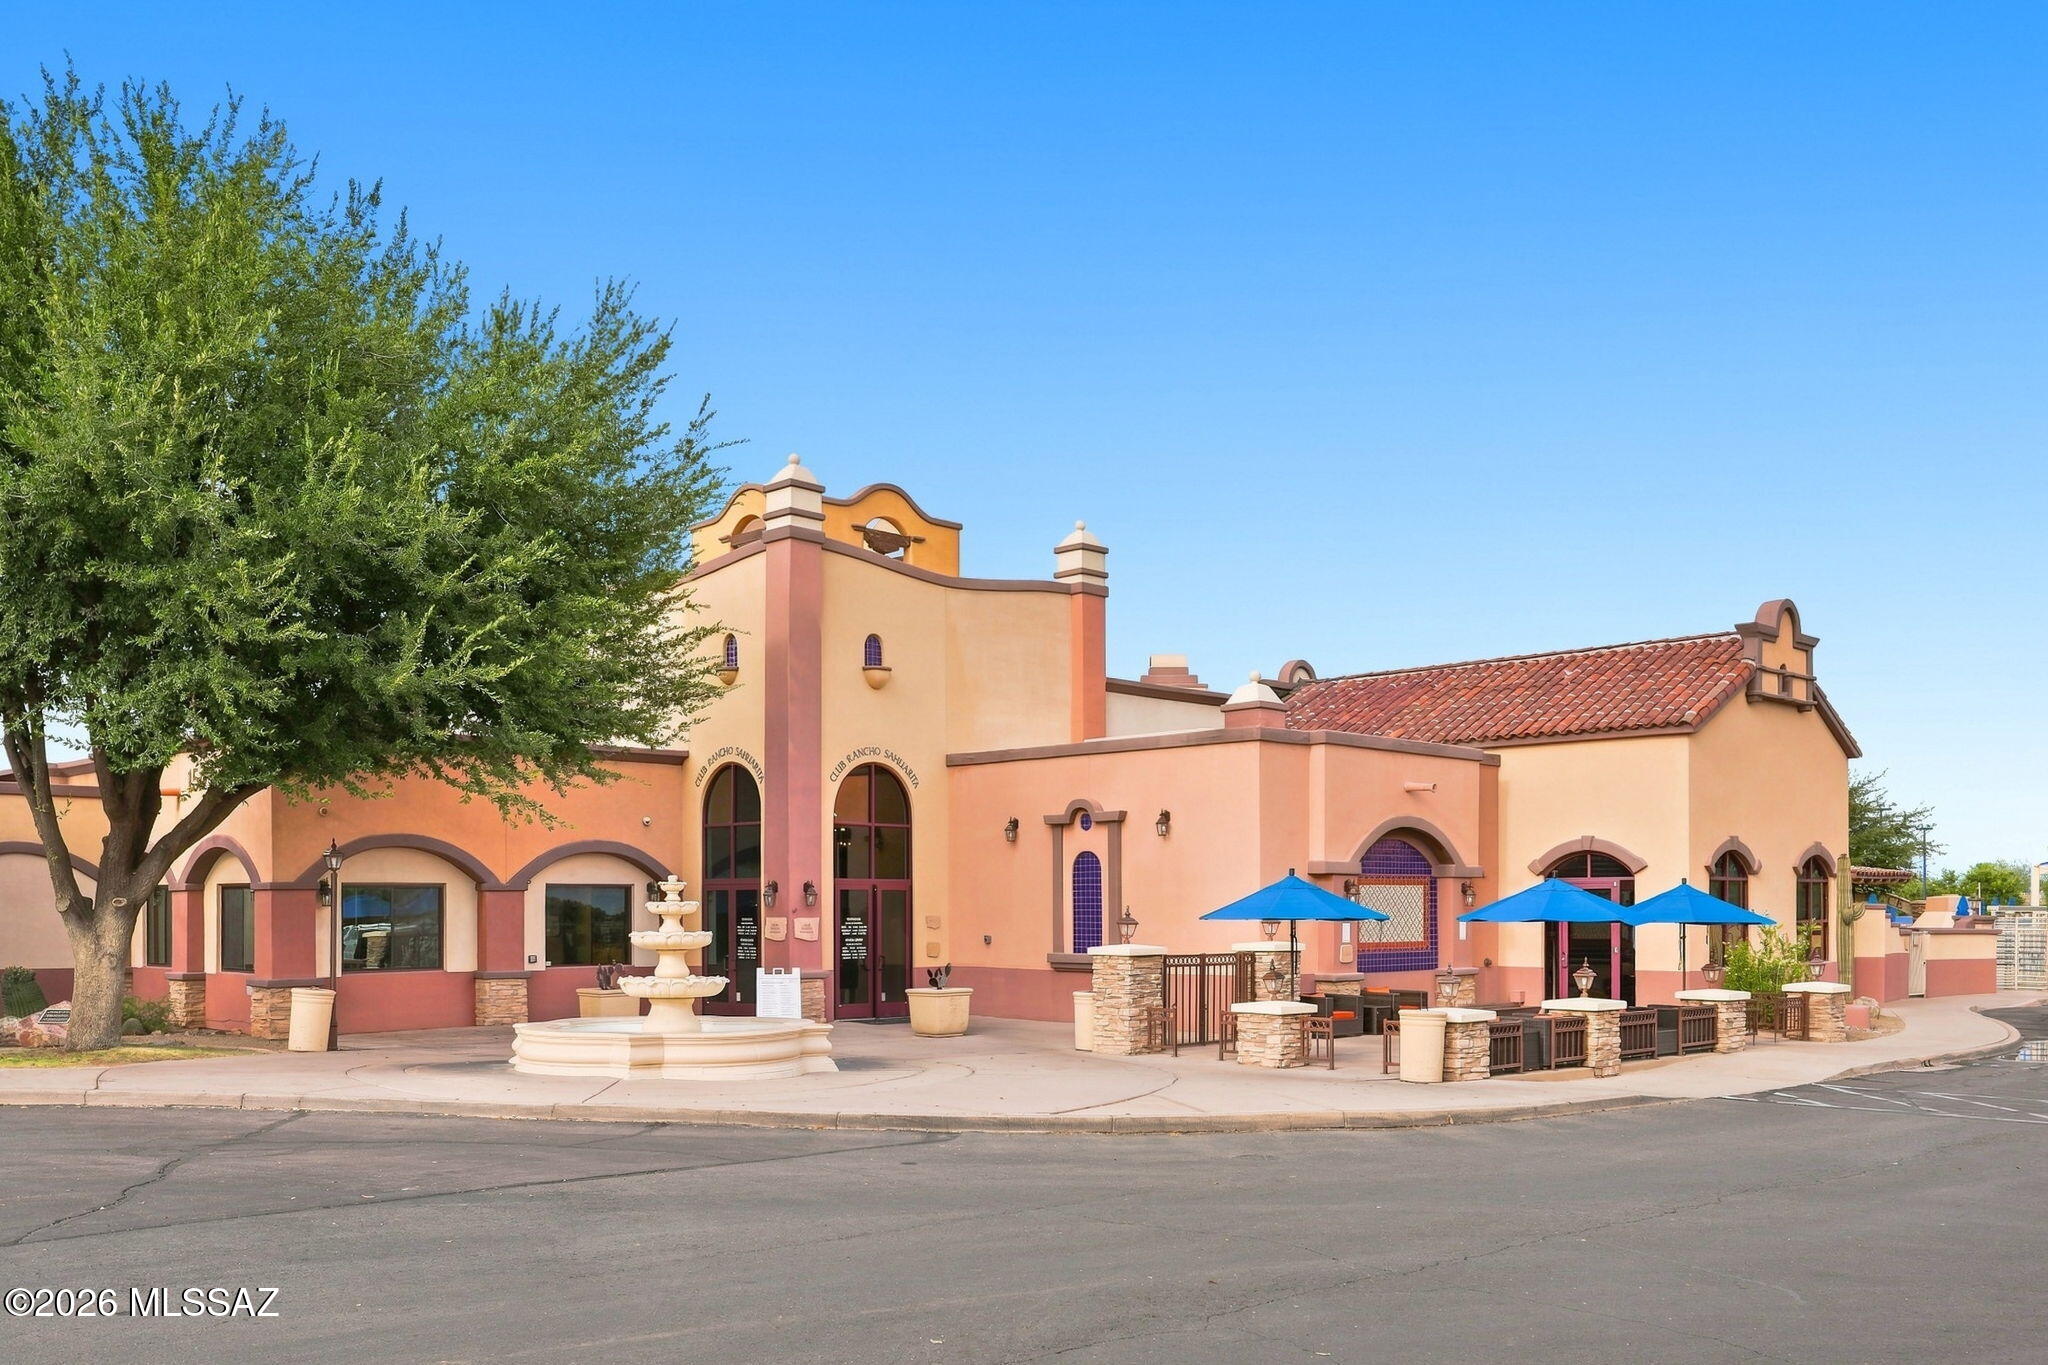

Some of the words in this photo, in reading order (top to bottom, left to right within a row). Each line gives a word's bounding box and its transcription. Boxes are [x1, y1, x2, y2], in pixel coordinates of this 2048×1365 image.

[694, 765, 708, 788] CLUB
[708, 746, 734, 767] RANCHO
[829, 760, 847, 782] CLUB
[846, 746, 881, 763] RANCHO
[884, 749, 920, 789] SAHUARITA
